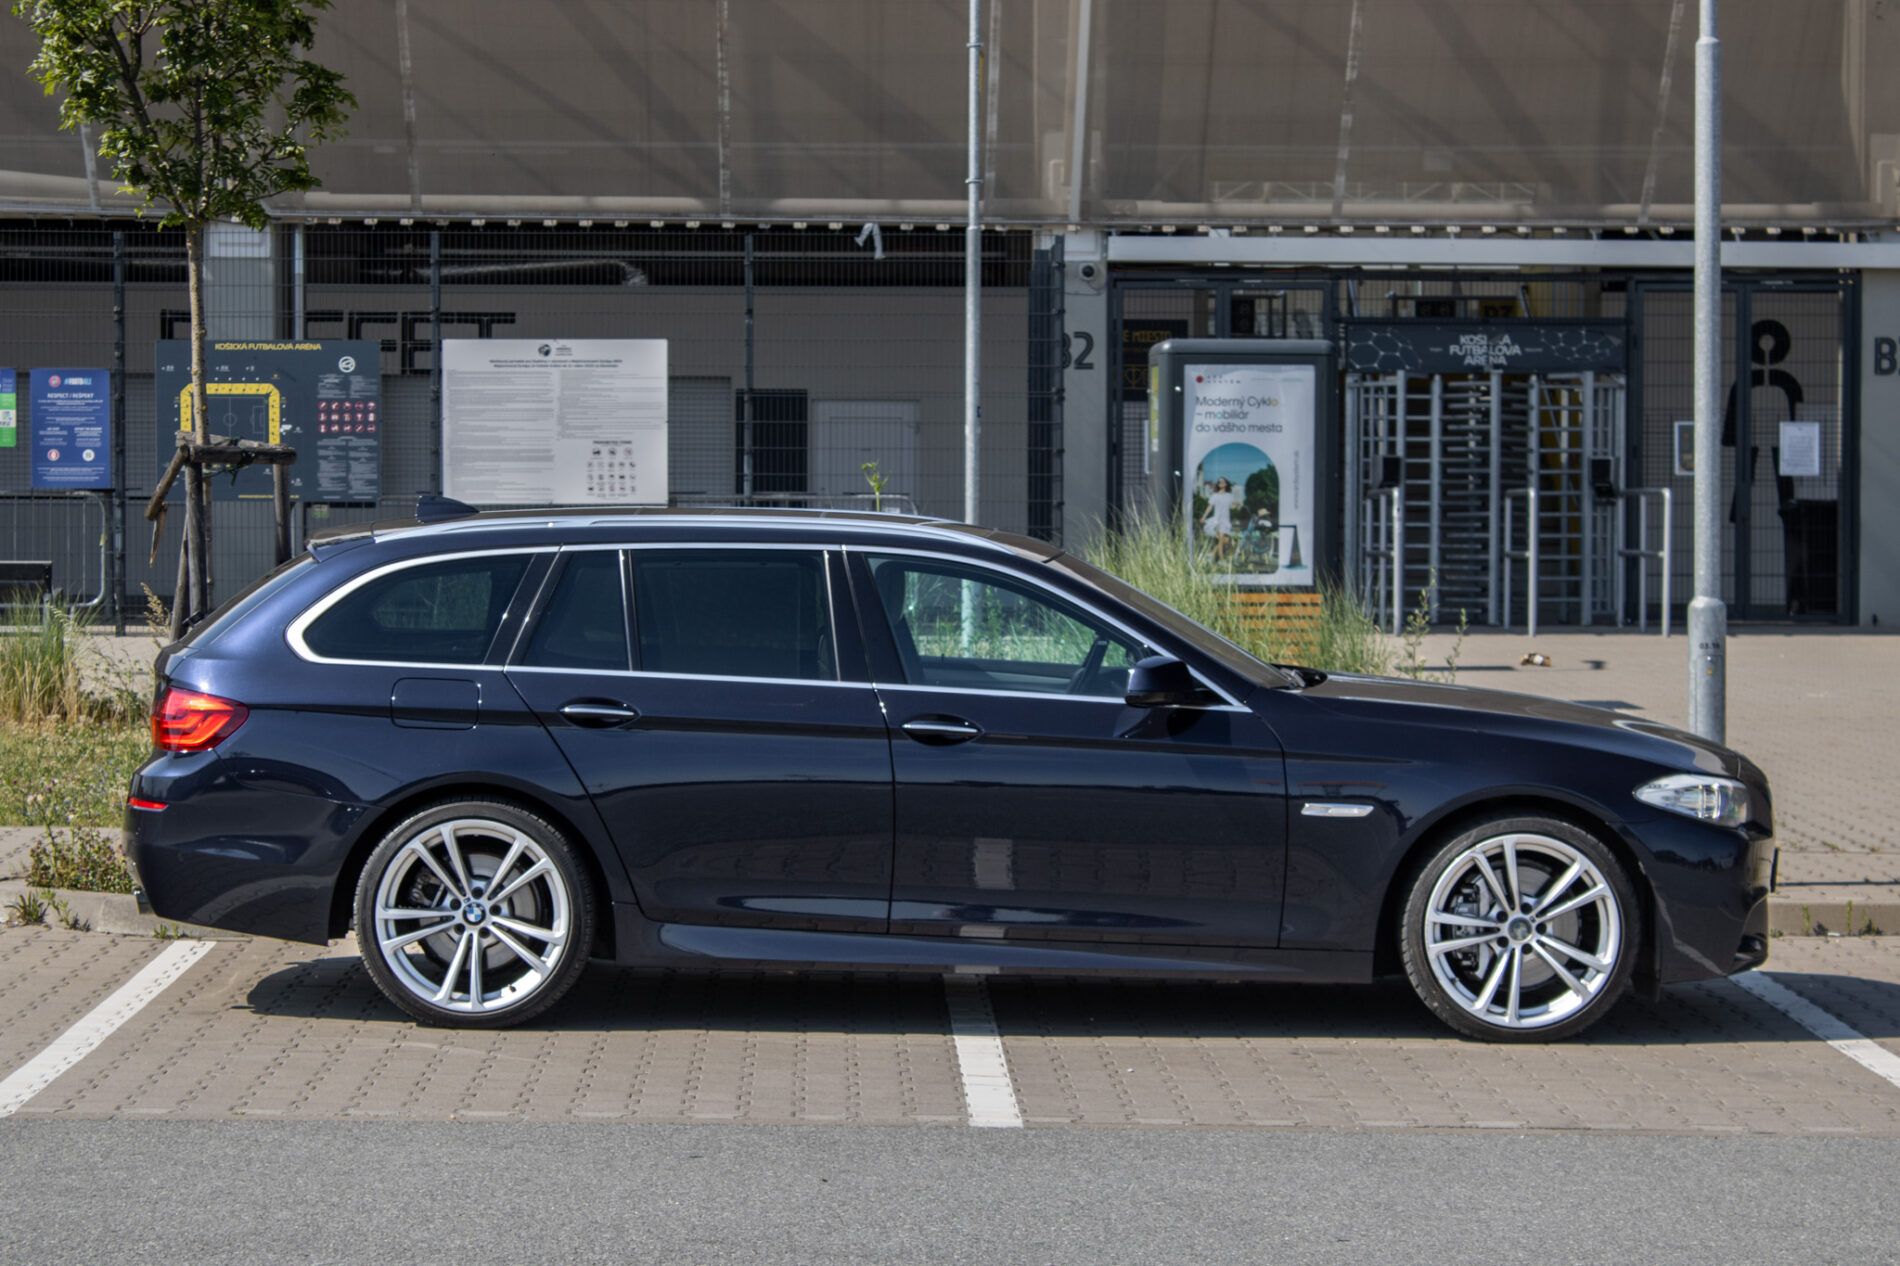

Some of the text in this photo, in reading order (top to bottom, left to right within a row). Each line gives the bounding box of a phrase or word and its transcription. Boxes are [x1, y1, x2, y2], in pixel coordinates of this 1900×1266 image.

[1873, 336, 1900, 376] B
[1195, 395, 1279, 408] Moderný Cyklo
[1195, 421, 1283, 433] do vášho mesta
